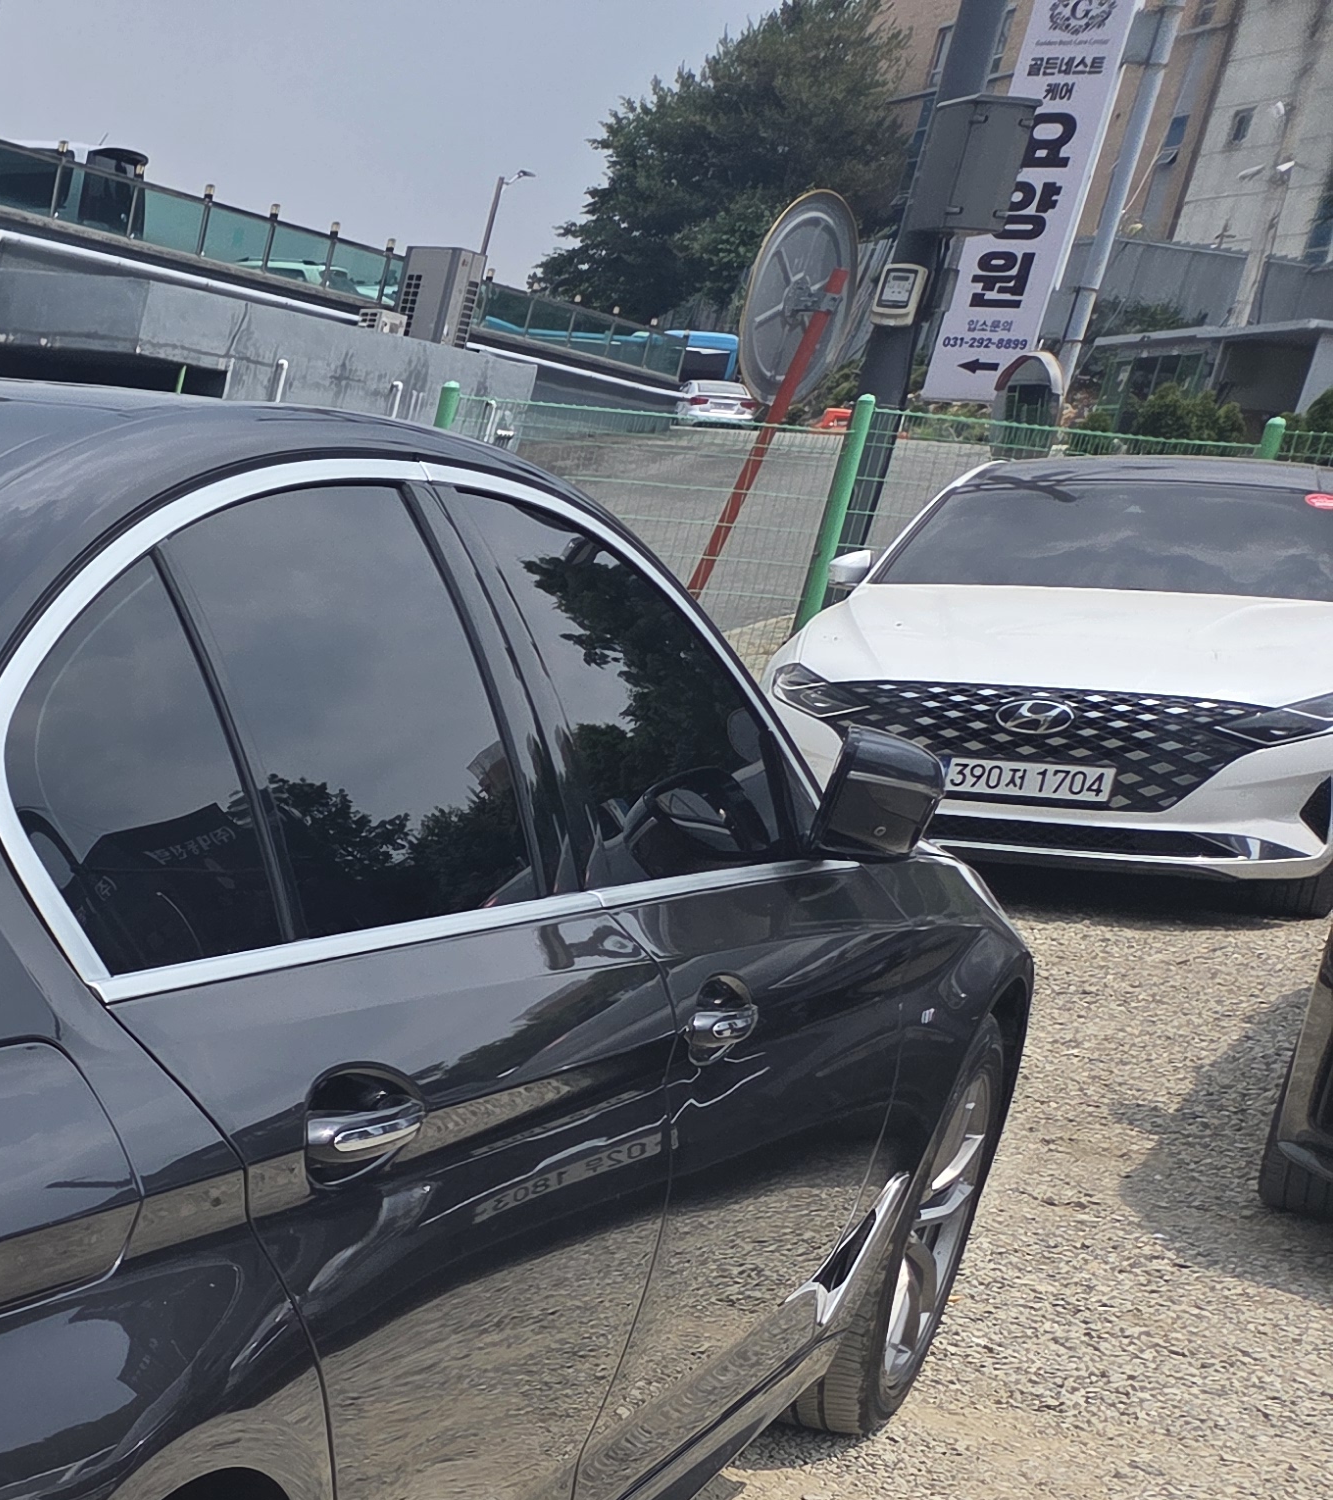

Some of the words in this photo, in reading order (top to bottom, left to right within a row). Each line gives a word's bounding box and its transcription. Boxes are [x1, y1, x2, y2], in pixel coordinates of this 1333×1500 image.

[1027, 56, 1106, 77] 골든네스트
[1043, 82, 1076, 101] 케어
[969, 112, 1077, 308] 요양원
[967, 320, 1013, 332] 입소문의
[942, 336, 1028, 350] 031-292-8899
[950, 763, 1028, 791] 390저
[1036, 767, 1105, 797] 1704
